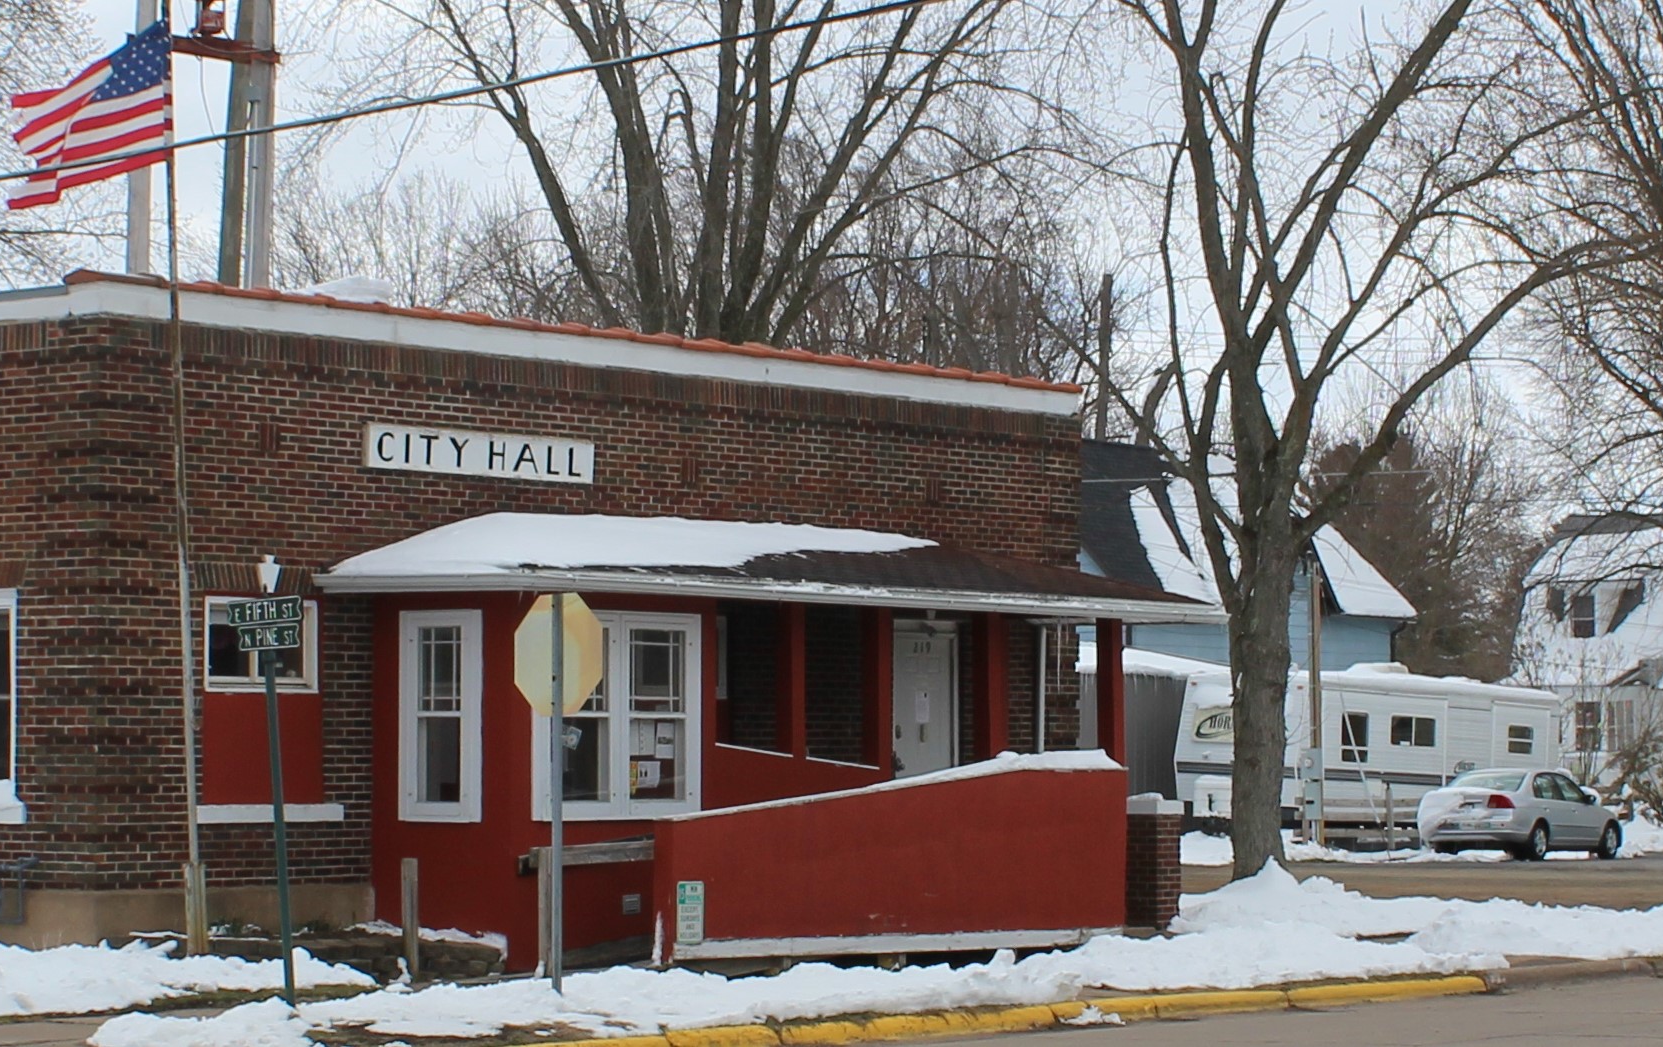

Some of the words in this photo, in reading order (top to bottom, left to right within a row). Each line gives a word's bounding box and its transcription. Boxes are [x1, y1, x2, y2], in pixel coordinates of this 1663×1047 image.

[376, 431, 470, 468] CITY
[488, 440, 582, 477] HALL
[234, 608, 242, 623] E
[245, 601, 277, 621] FIFTH
[281, 603, 293, 619] ST
[244, 633, 252, 647] N
[255, 627, 279, 646] PINE
[283, 630, 294, 645] ST
[1209, 715, 1234, 729] HOR
